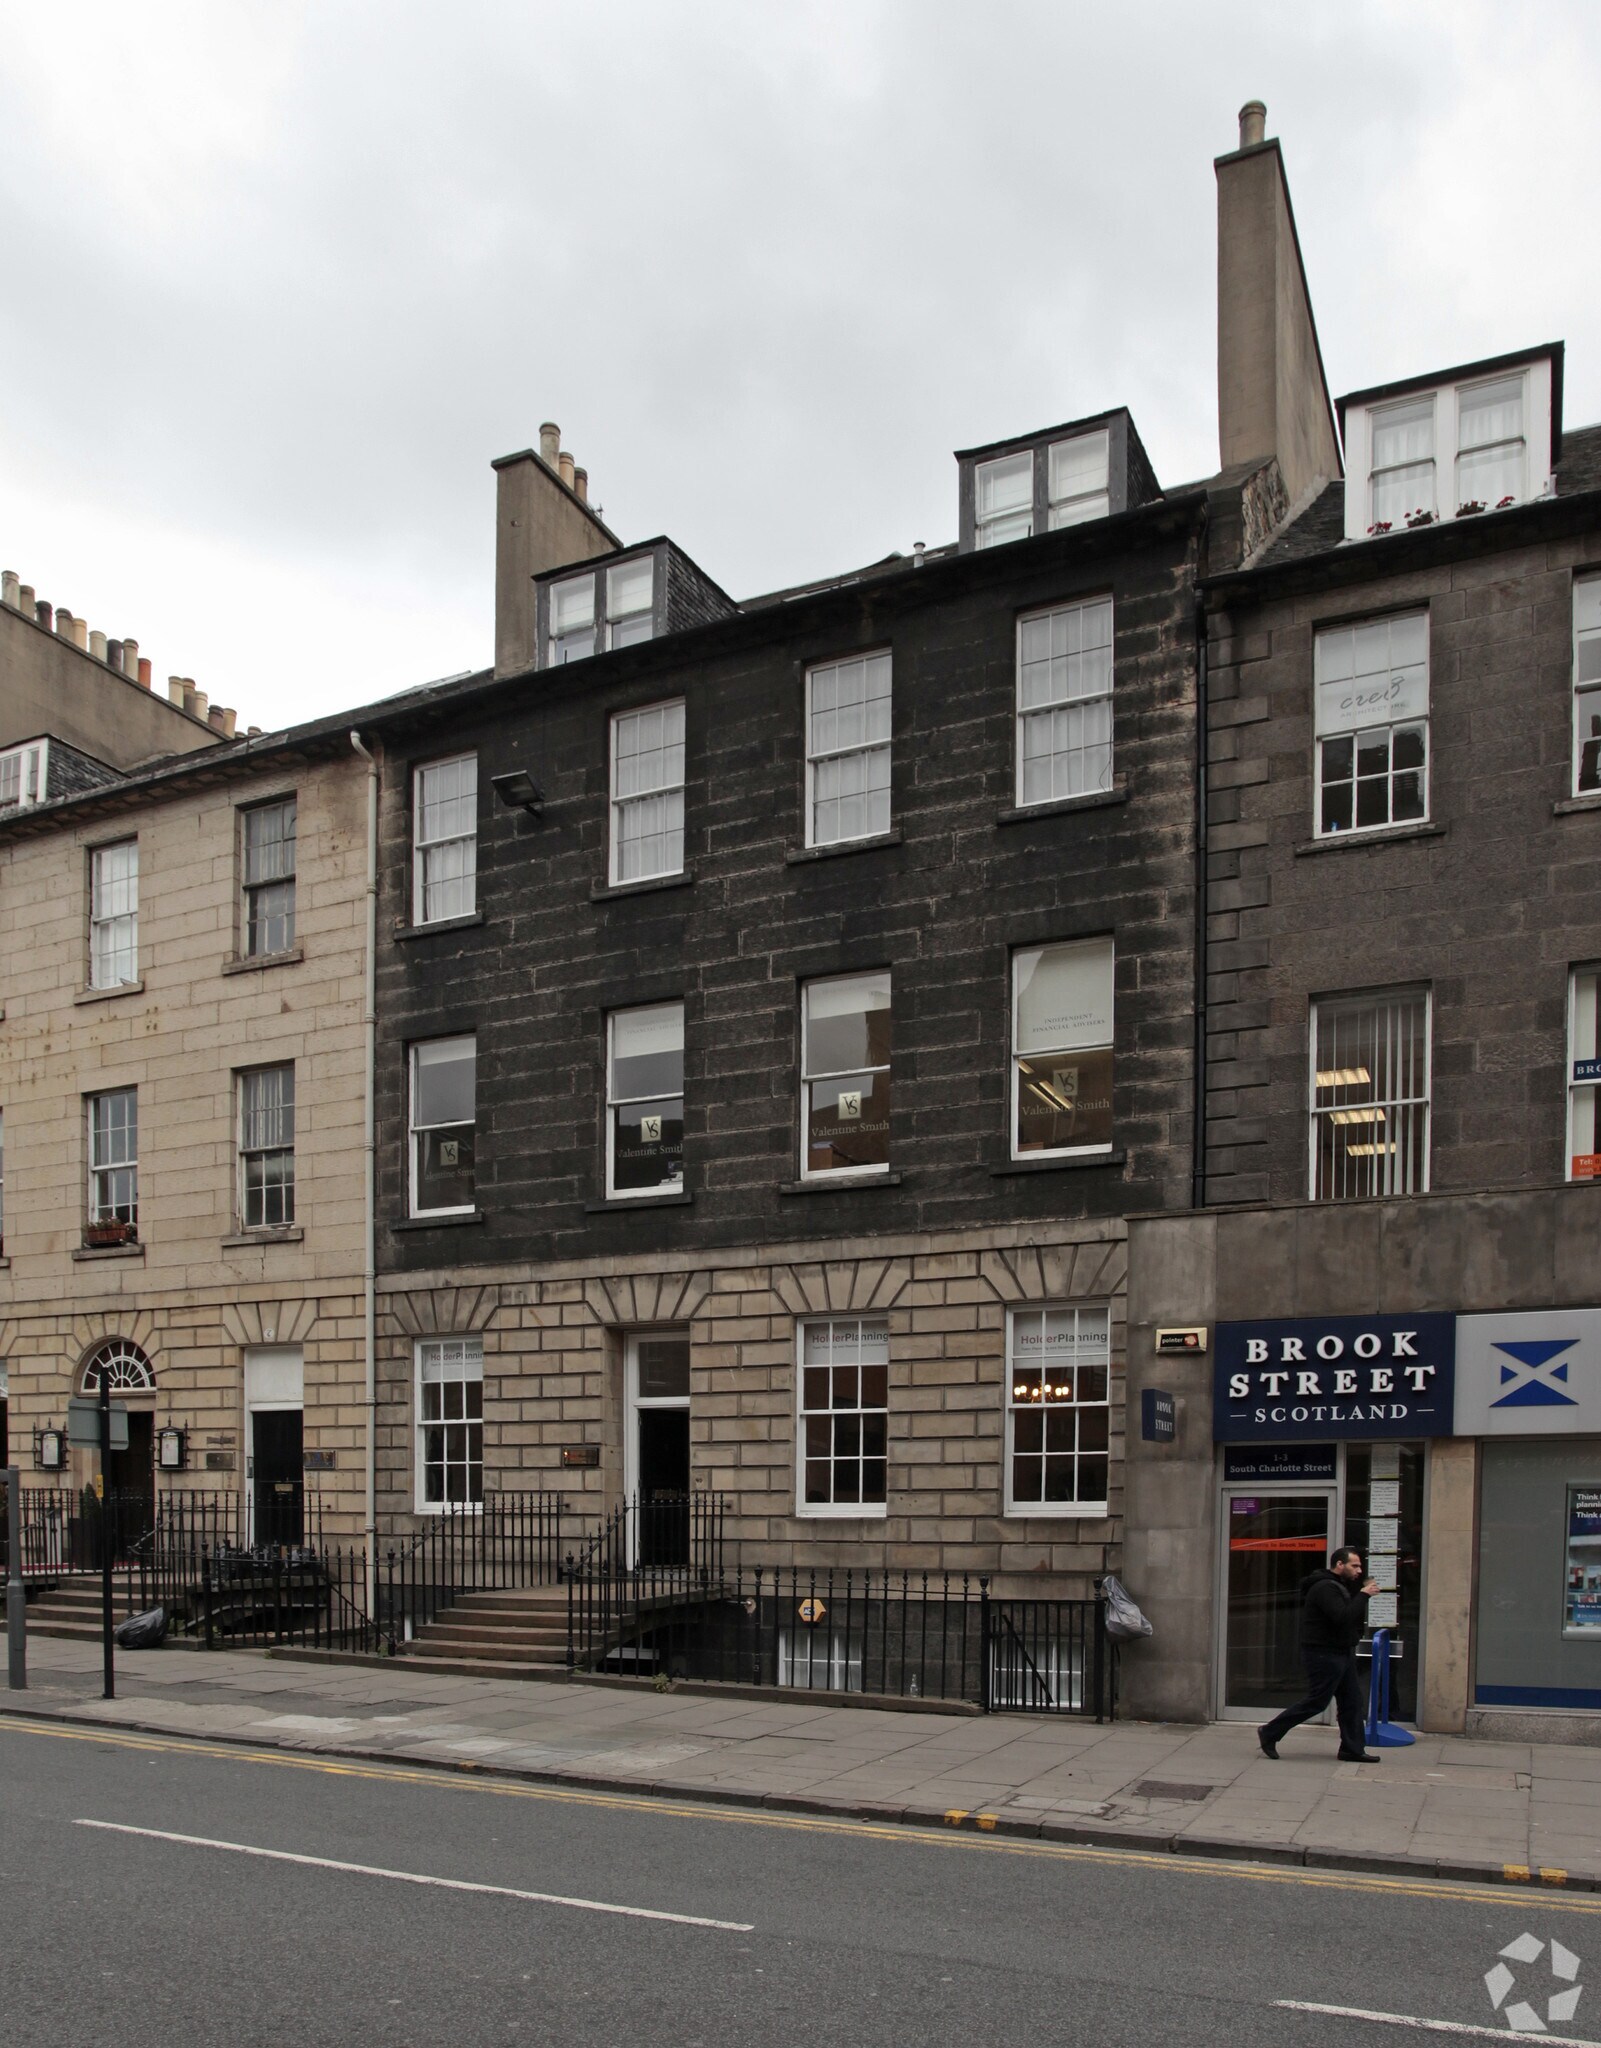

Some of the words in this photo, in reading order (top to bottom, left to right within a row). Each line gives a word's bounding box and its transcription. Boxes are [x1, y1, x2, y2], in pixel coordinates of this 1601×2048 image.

[1341, 703, 1406, 717] ARHITECTRE
[1044, 1013, 1093, 1024] INDEPENDENT
[1032, 1024, 1070, 1033] FINANCIAL
[1076, 1098, 1110, 1111] Smith
[811, 1126, 857, 1137] Valentine
[859, 1119, 890, 1132] Smith
[616, 1147, 657, 1158] Valentine
[1246, 1331, 1419, 1363] BROOK
[1229, 1365, 1436, 1398] STREET
[1255, 1404, 1408, 1423] SCOTLAND
[1155, 1419, 1173, 1432] STREET
[1274, 1454, 1288, 1462] 1-3
[1230, 1464, 1256, 1473] South
[1259, 1464, 1301, 1473] Charlotte
[1304, 1463, 1332, 1472] Street
[1576, 1493, 1599, 1501] Think
[1576, 1511, 1598, 1519] Think
